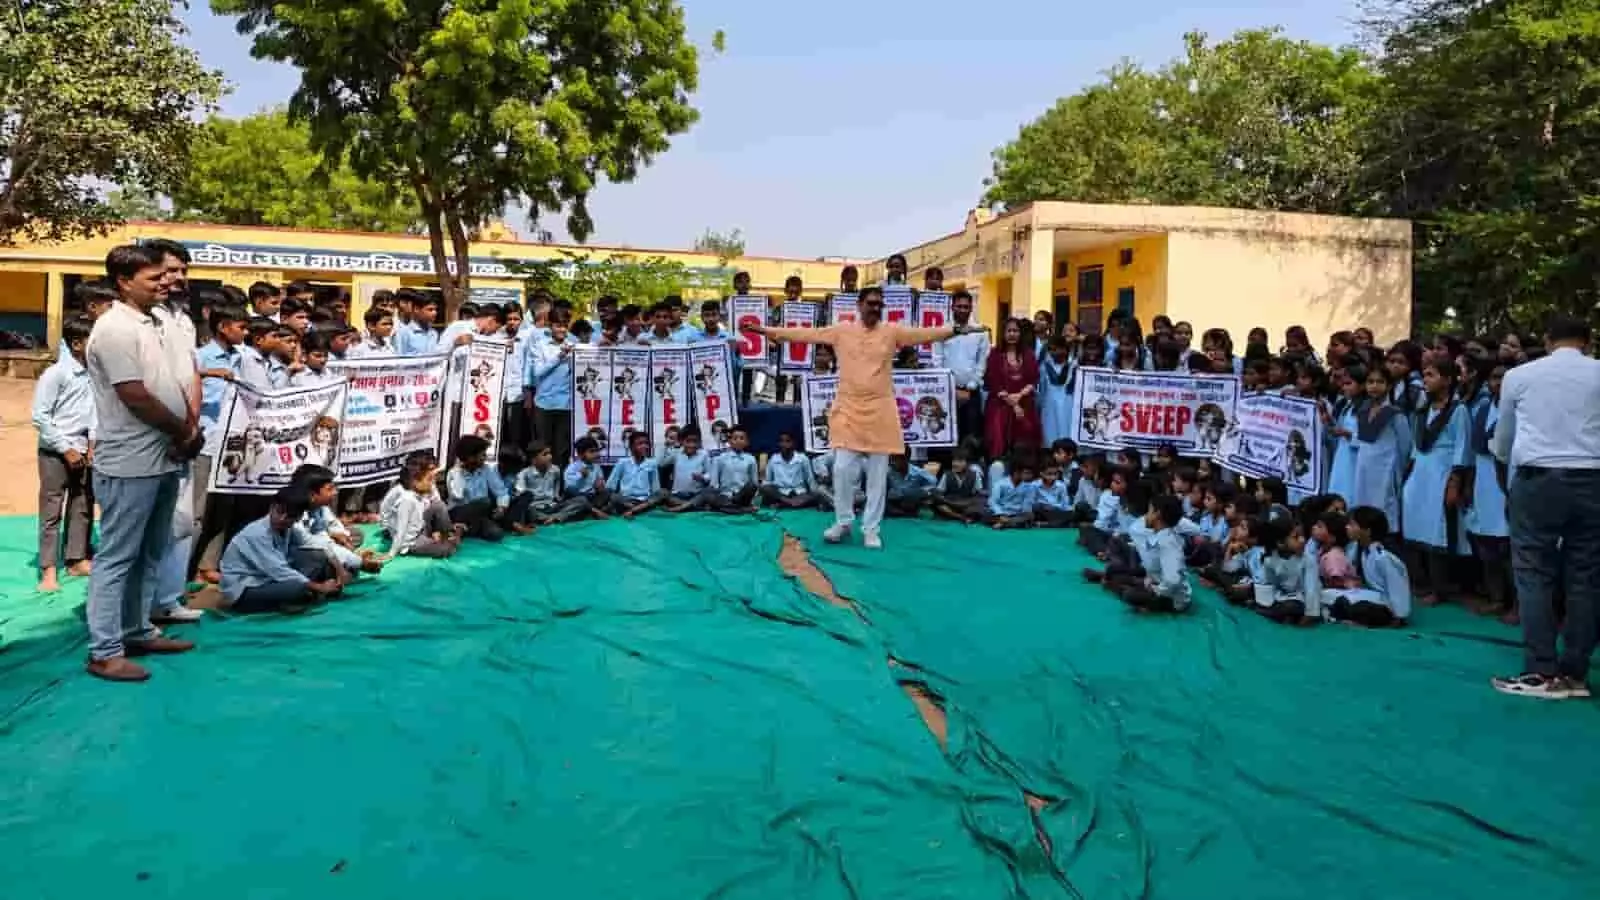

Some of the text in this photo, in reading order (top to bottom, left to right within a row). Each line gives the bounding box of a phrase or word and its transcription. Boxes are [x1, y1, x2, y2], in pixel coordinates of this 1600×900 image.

[310, 252, 424, 273] माध्यमिक
[738, 315, 762, 357] S
[474, 394, 490, 422] S
[583, 400, 602, 425] V
[622, 400, 635, 425] E
[664, 399, 677, 425] E
[706, 394, 721, 420] P
[1120, 401, 1191, 436] SVEEP
